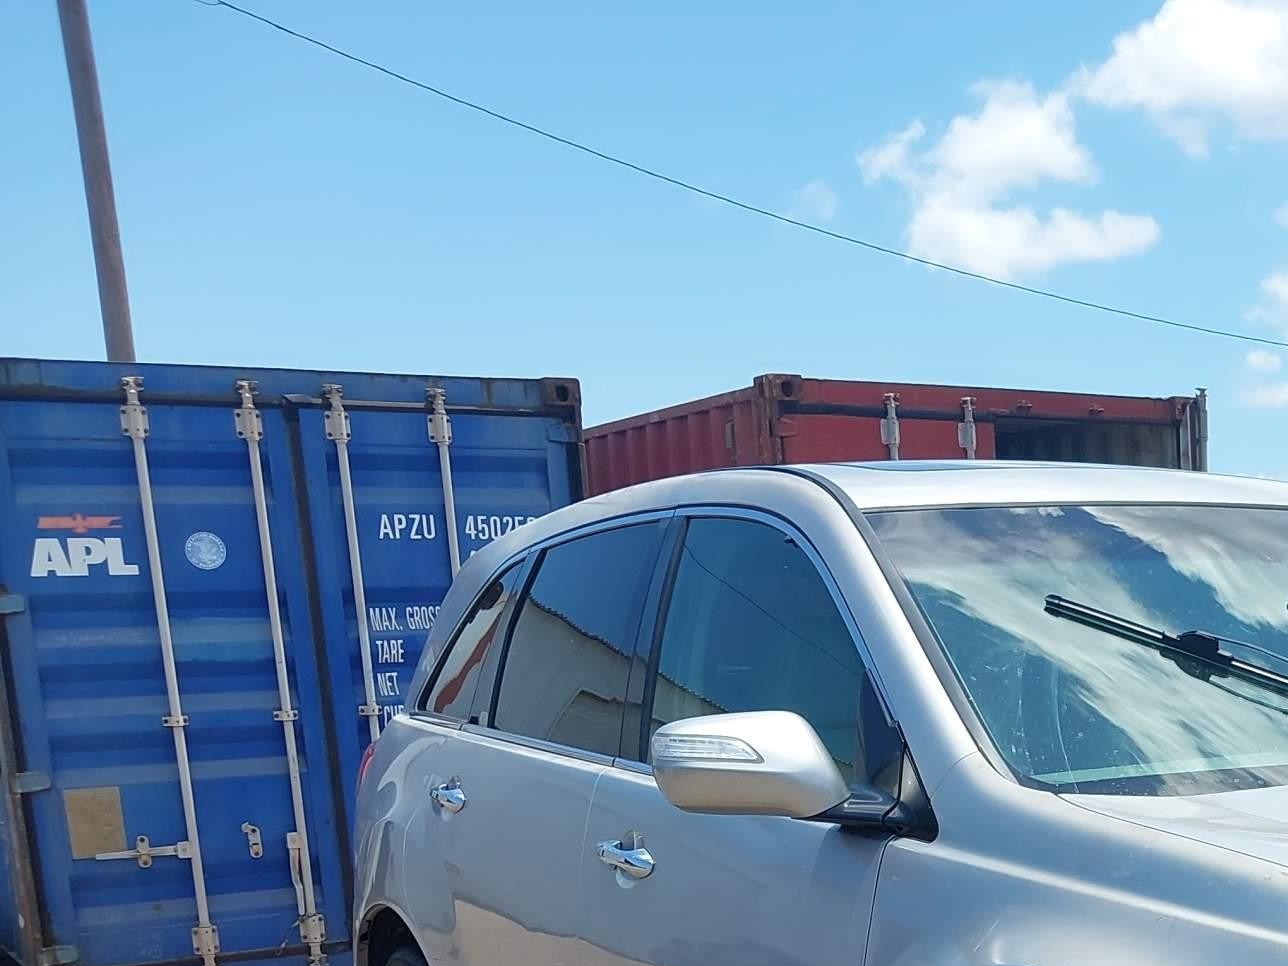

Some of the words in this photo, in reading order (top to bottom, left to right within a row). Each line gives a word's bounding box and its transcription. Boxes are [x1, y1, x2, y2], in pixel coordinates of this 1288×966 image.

[379, 513, 436, 540] APZU
[30, 537, 140, 577] APL
[369, 607, 403, 631] MAX.
[375, 639, 405, 664] TARE
[377, 672, 400, 696] NET
